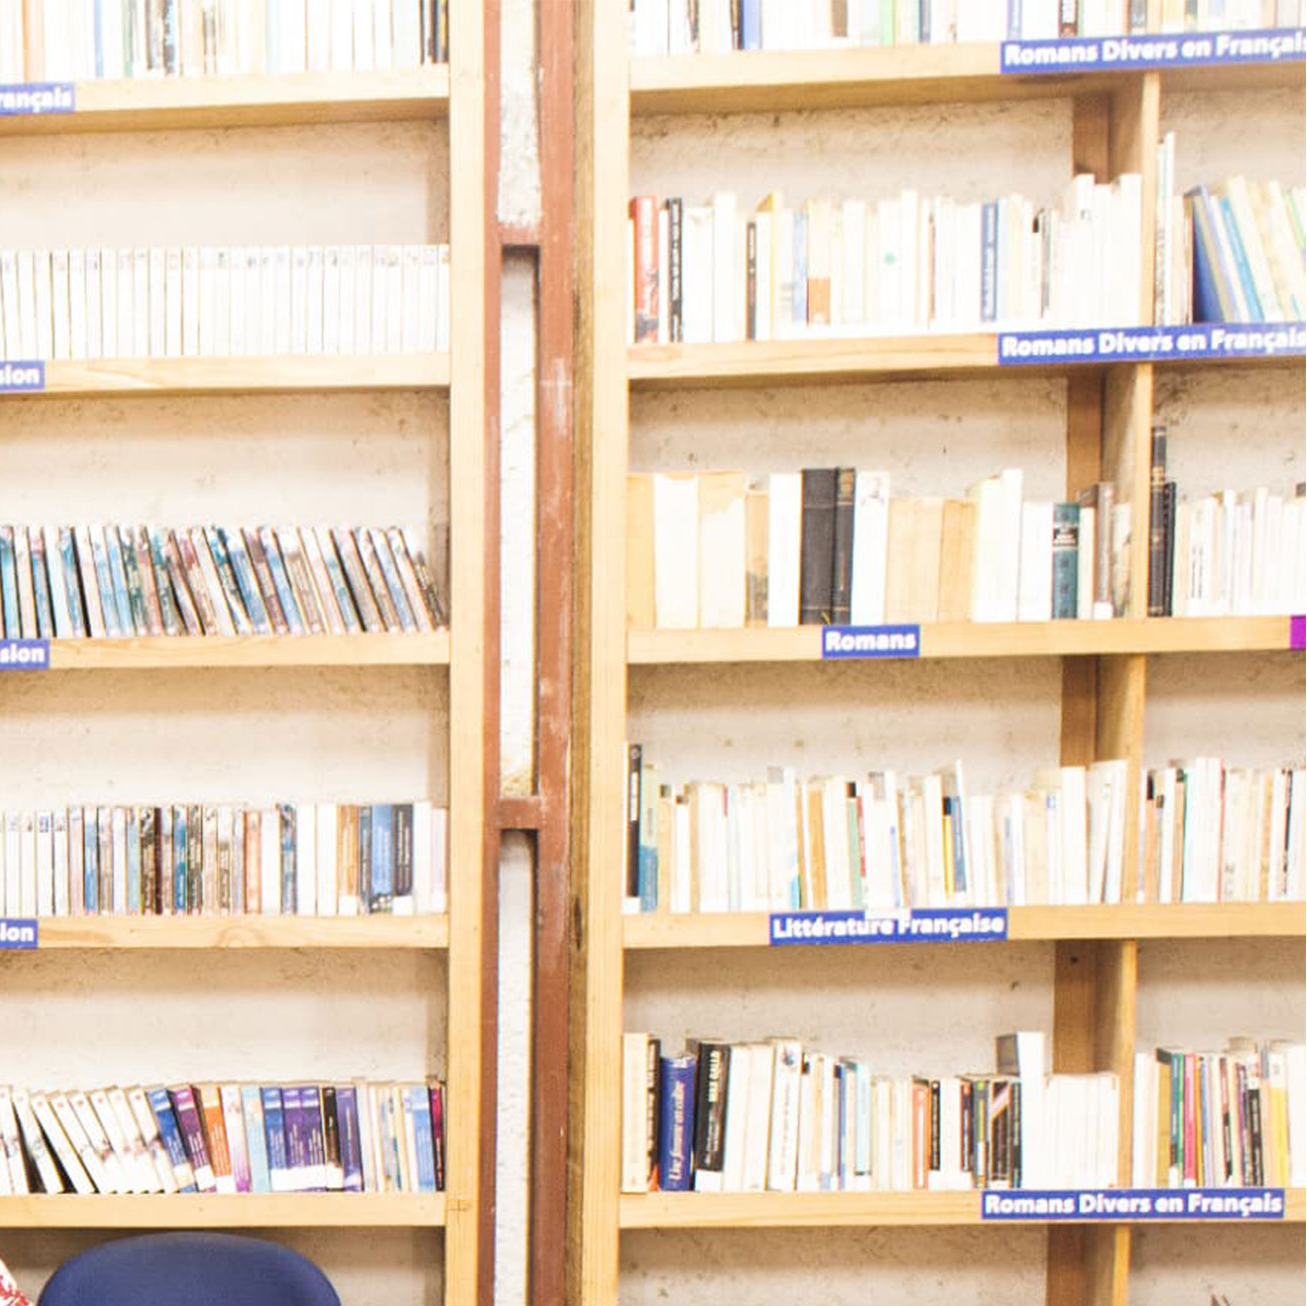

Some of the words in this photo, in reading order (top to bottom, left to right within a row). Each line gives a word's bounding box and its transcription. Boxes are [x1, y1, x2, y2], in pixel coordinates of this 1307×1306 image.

[1004, 43, 1099, 67] Romans
[1102, 40, 1178, 61] Divers
[1181, 39, 1212, 57] en
[1216, 33, 1306, 59] Françai
[1001, 336, 1095, 358] Romans
[1099, 332, 1174, 354] Divers
[1177, 333, 1207, 351] en
[824, 631, 918, 652] Romans
[773, 917, 894, 939] Littérature
[985, 1194, 1075, 1214] Romans
[1078, 1192, 1152, 1214] Divers
[1155, 1196, 1184, 1213] en
[1187, 1191, 1283, 1218] Français
